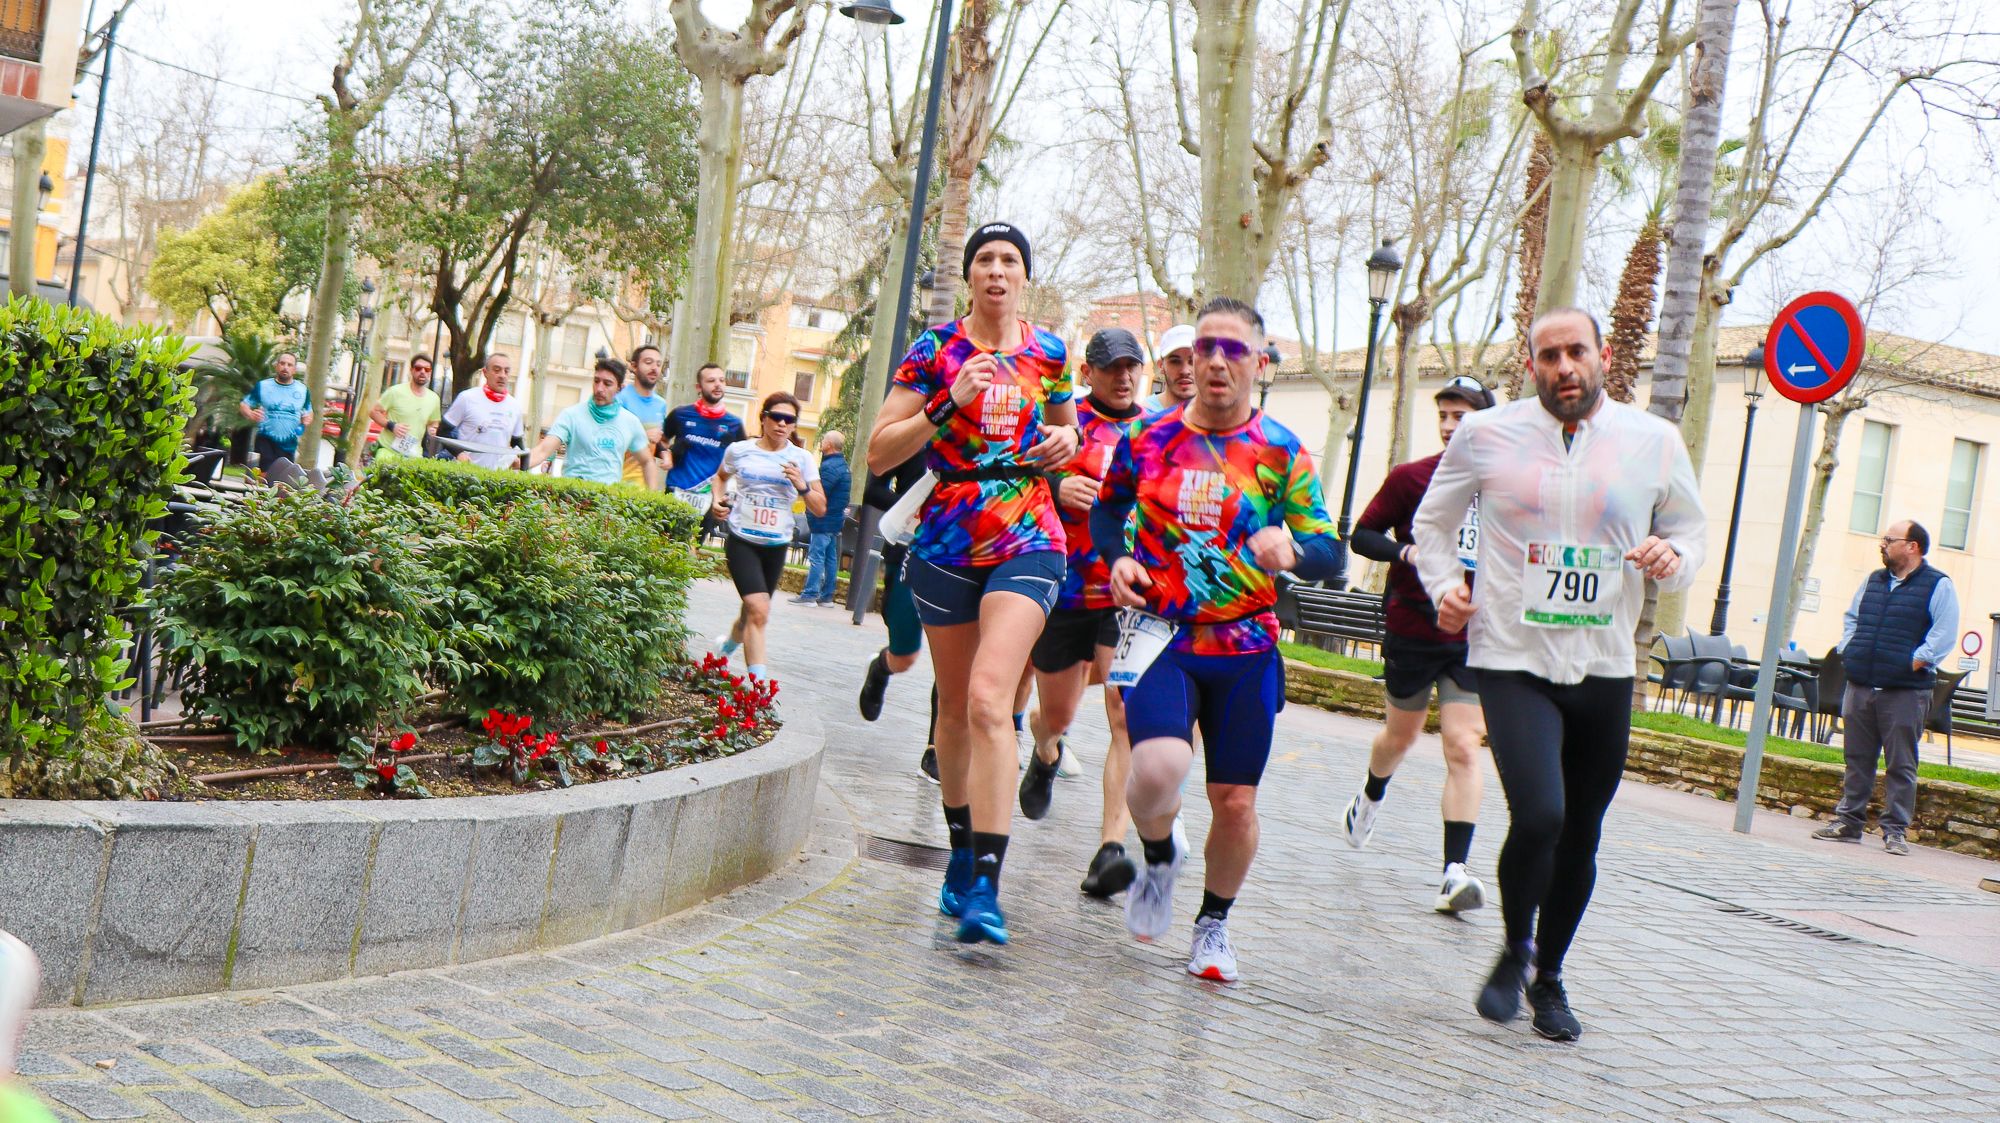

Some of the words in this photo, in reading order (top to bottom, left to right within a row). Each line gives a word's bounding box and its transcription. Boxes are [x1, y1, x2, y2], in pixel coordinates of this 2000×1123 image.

[983, 383, 1008, 404] XII
[982, 403, 1007, 415] MEDIA
[1180, 469, 1210, 490] XII
[753, 509, 777, 526] 105
[1546, 569, 1599, 604] 790
